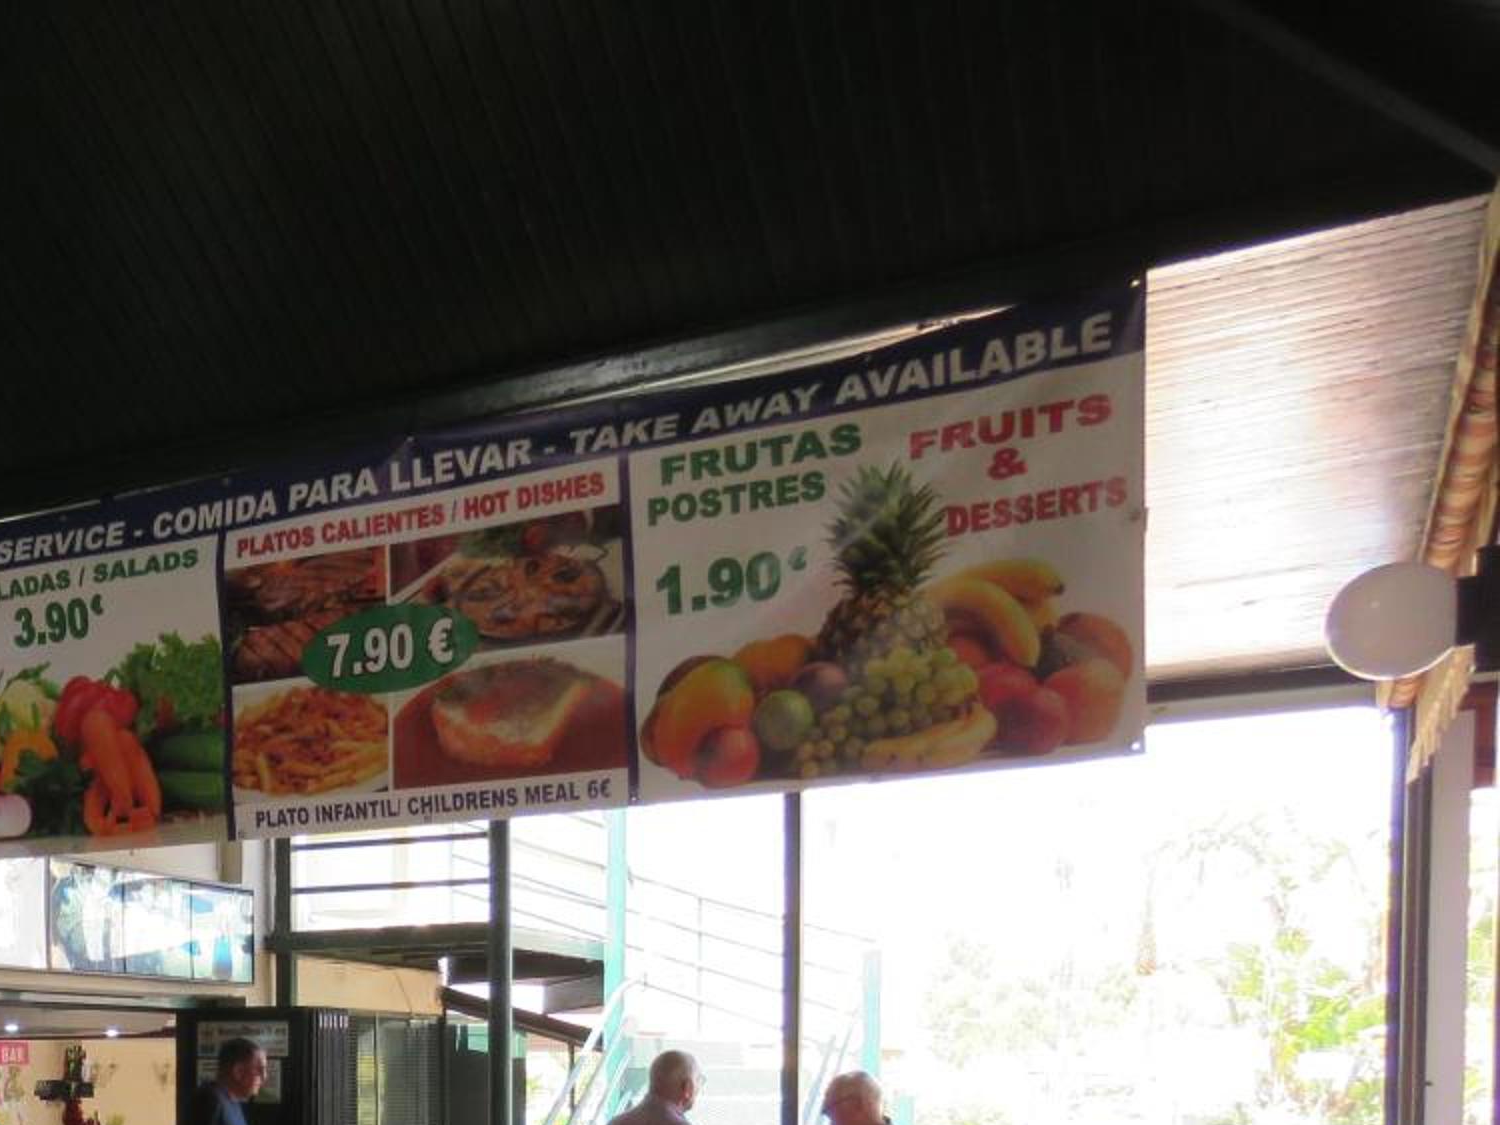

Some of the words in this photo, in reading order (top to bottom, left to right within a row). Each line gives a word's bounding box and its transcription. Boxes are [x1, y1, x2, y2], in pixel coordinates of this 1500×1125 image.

[152, 490, 277, 539] COMIDA
[287, 468, 378, 512] PARA
[390, 438, 532, 492] LLEVAR
[569, 414, 681, 455] TAKE
[691, 383, 820, 435] AWAY
[835, 312, 1113, 405] AVAILABLE
[659, 423, 862, 486] FRUTAS
[909, 394, 1113, 460] FRUITS
[987, 447, 1028, 480] &
[236, 526, 314, 557] PLATOS
[322, 504, 444, 543] CALIENTES
[463, 491, 510, 520] HOT
[516, 472, 606, 506] DISHES
[648, 470, 825, 526] POSTRES
[945, 476, 1127, 537] DESSERTS
[93, 550, 198, 583] SALADS
[326, 624, 413, 677] 7.90
[428, 618, 453, 663] €
[256, 807, 309, 828] PLATO
[408, 787, 516, 815] CHILDRENS
[525, 781, 580, 805] MEAL
